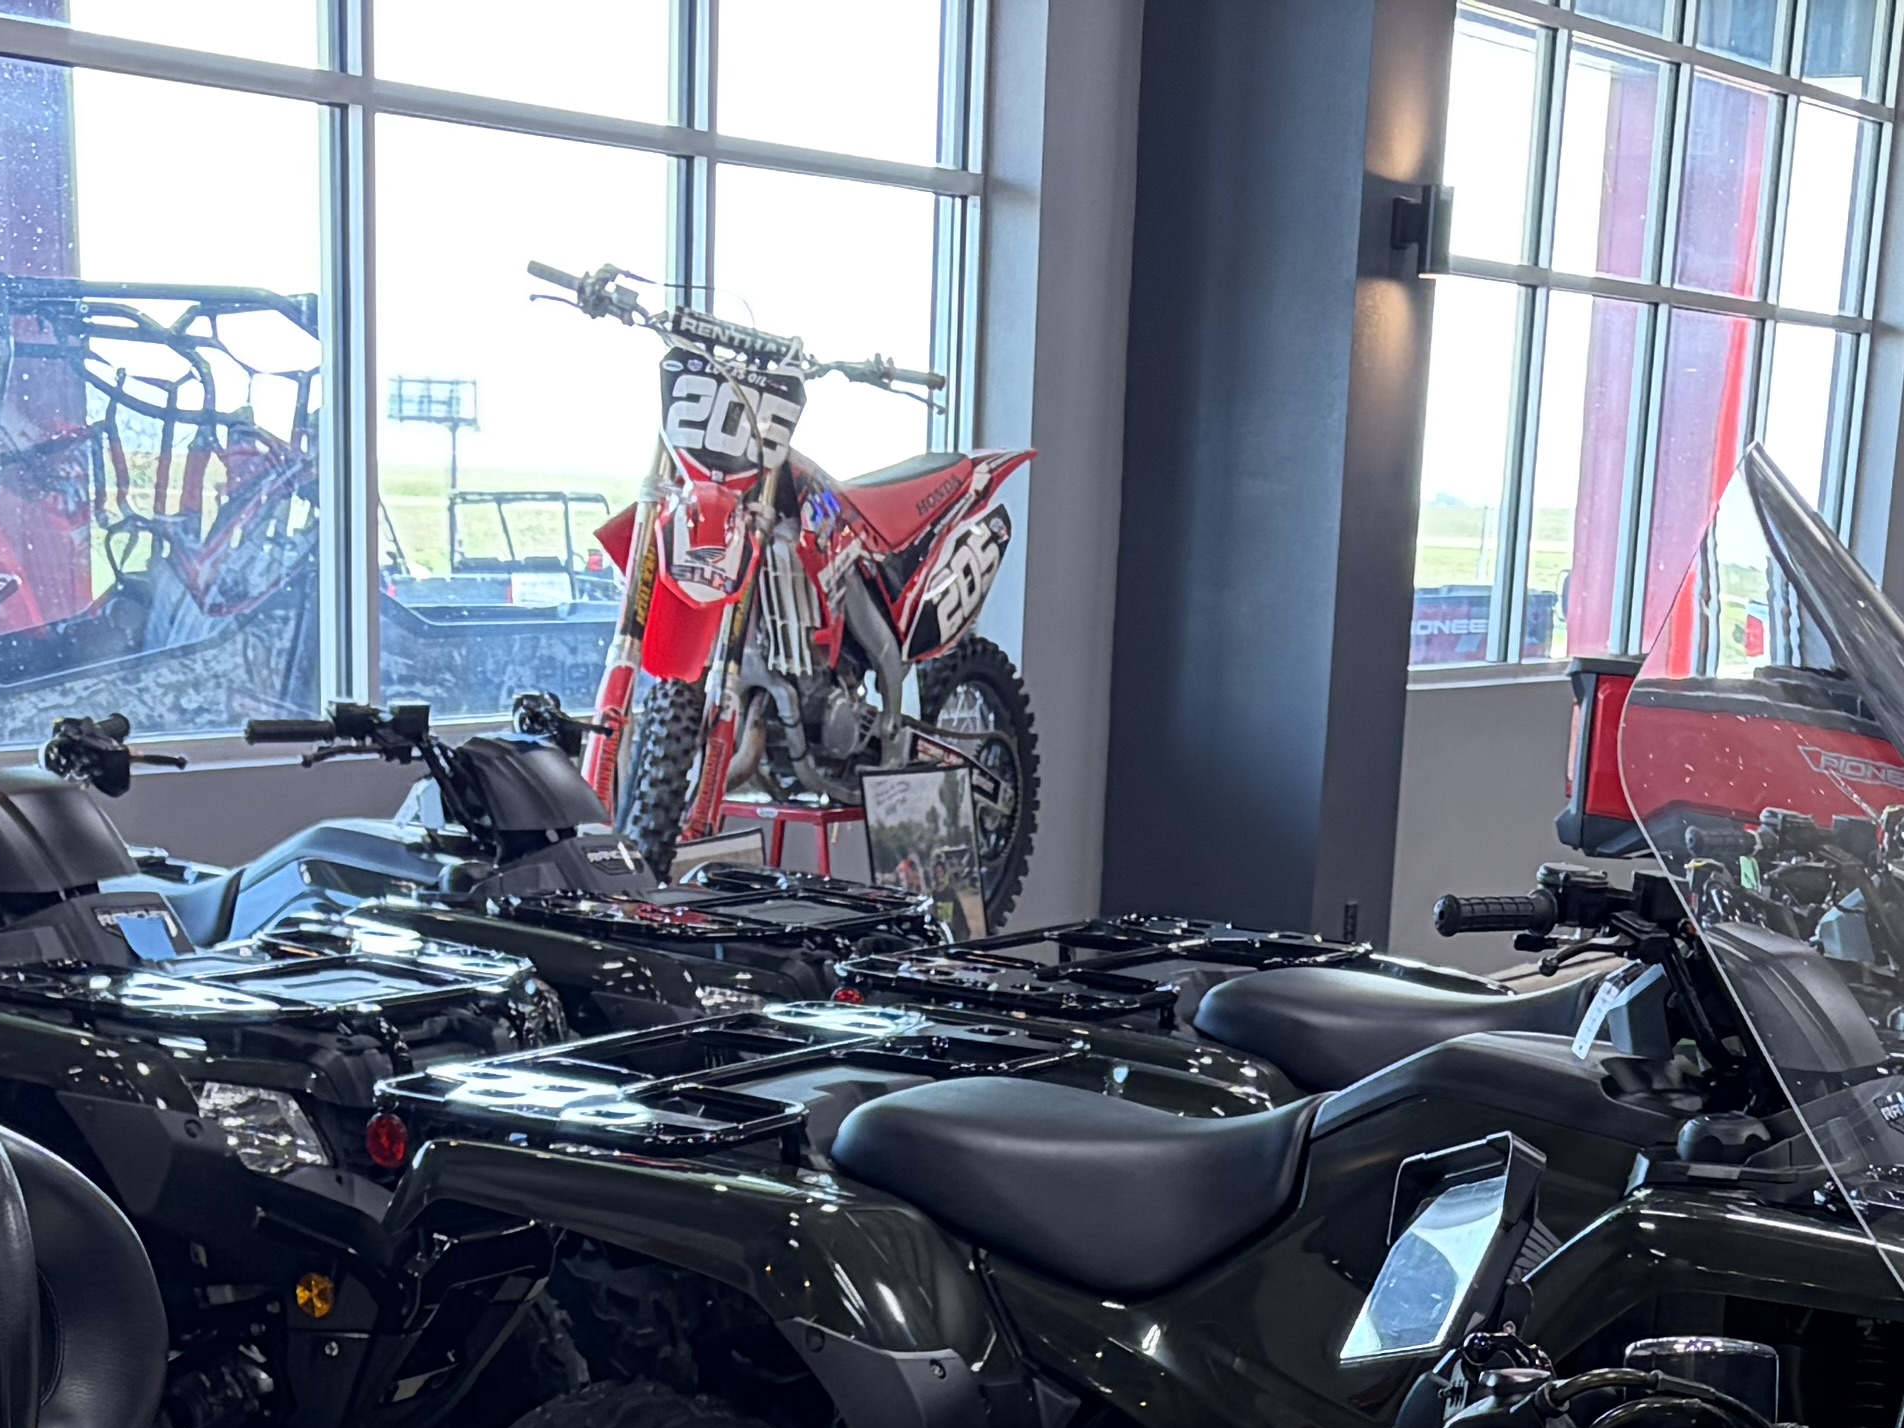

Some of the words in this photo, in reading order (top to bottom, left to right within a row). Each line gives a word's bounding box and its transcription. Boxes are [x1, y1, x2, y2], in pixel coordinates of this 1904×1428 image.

[679, 316, 786, 354] RENTHA
[665, 374, 801, 469] 205
[916, 474, 964, 516] HONDA
[928, 521, 1000, 645] 205
